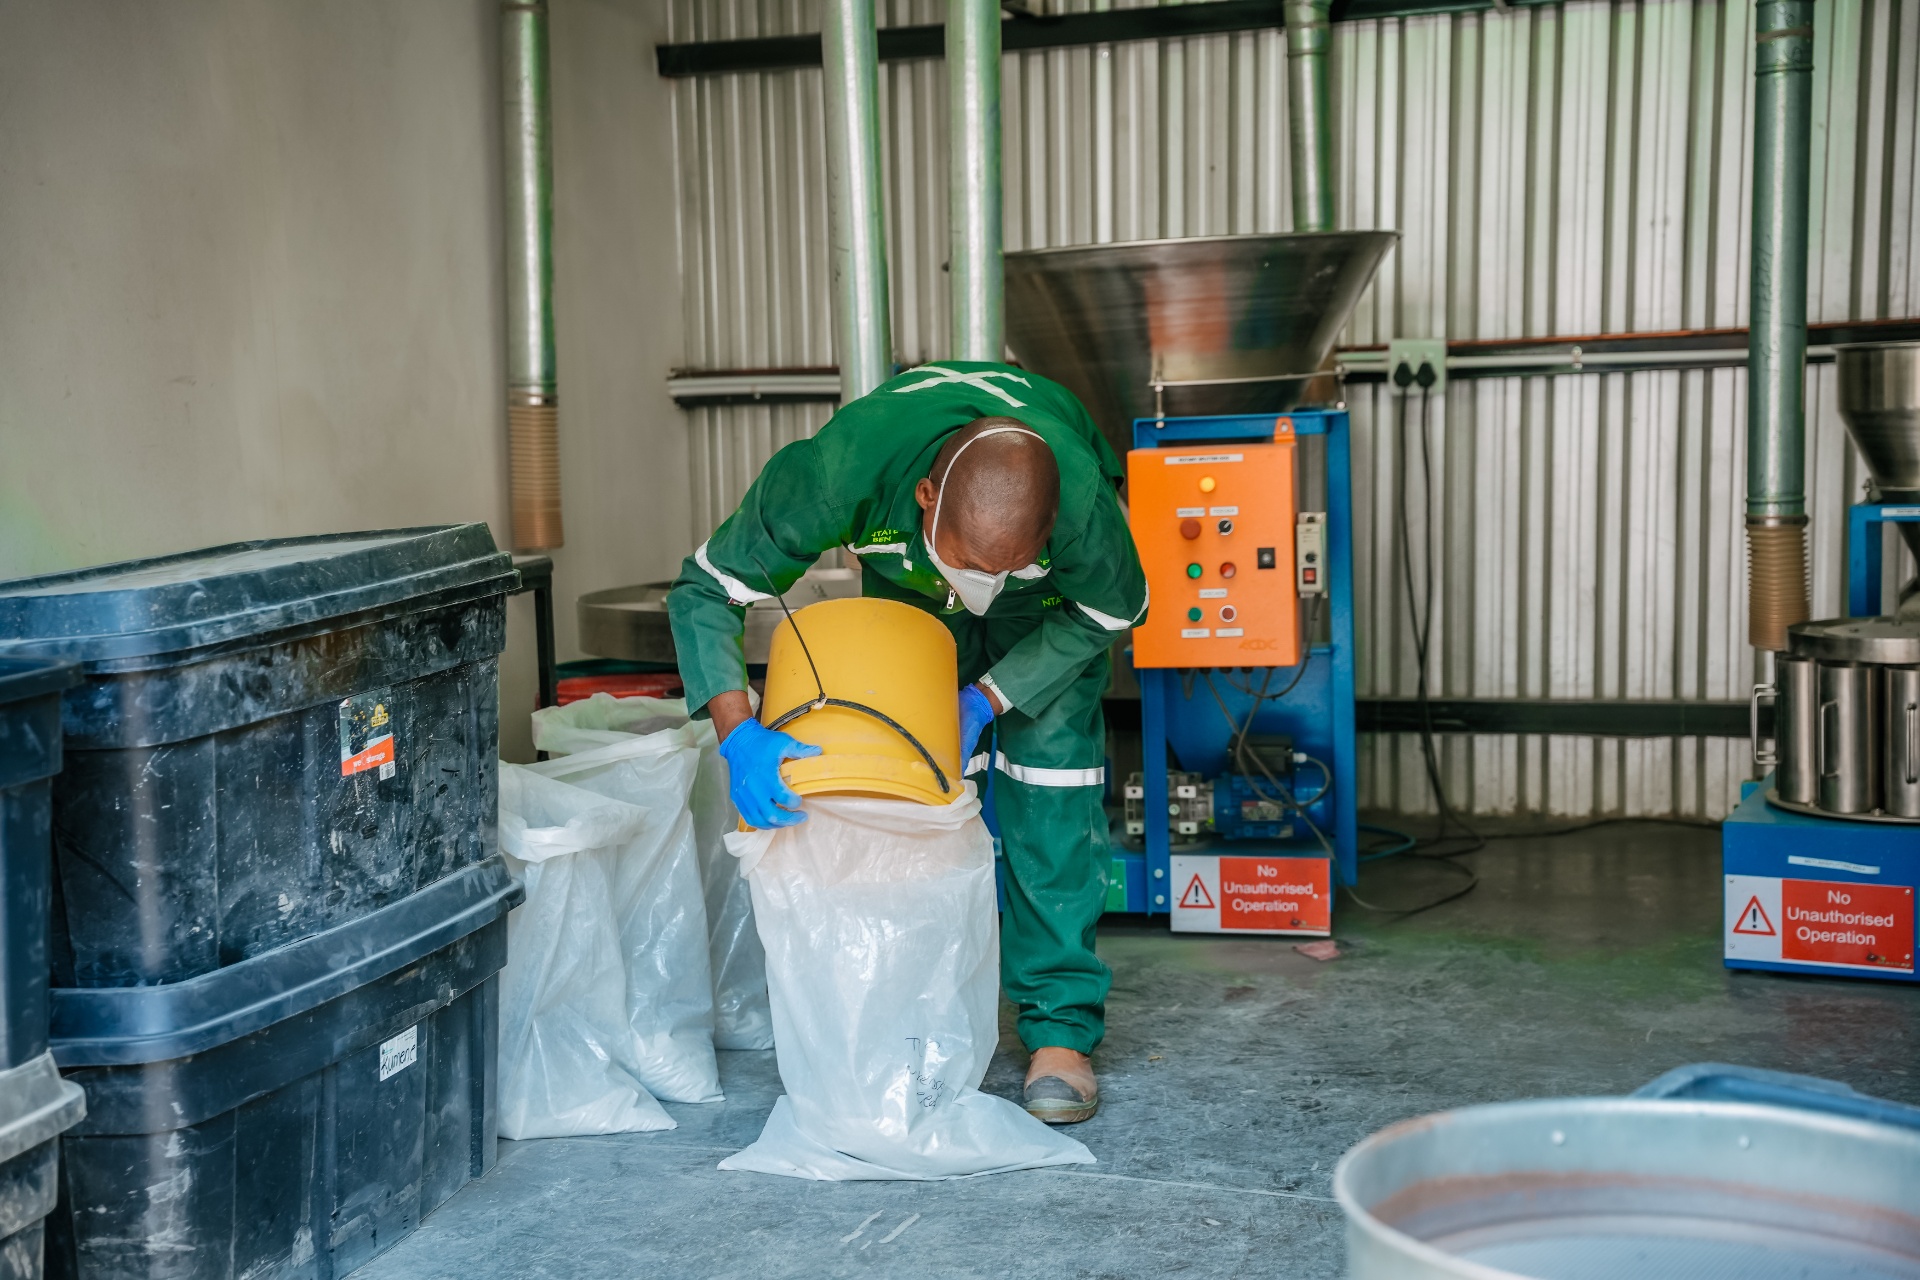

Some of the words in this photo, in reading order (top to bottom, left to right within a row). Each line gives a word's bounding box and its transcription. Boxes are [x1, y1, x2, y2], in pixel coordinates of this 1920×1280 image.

[1257, 865, 1278, 877] No
[1223, 881, 1314, 895] Unauthorised
[1827, 890, 1851, 905] No
[1231, 898, 1299, 914] Operation
[1786, 906, 1894, 927] Unauthorised
[1796, 926, 1876, 945] Operation
